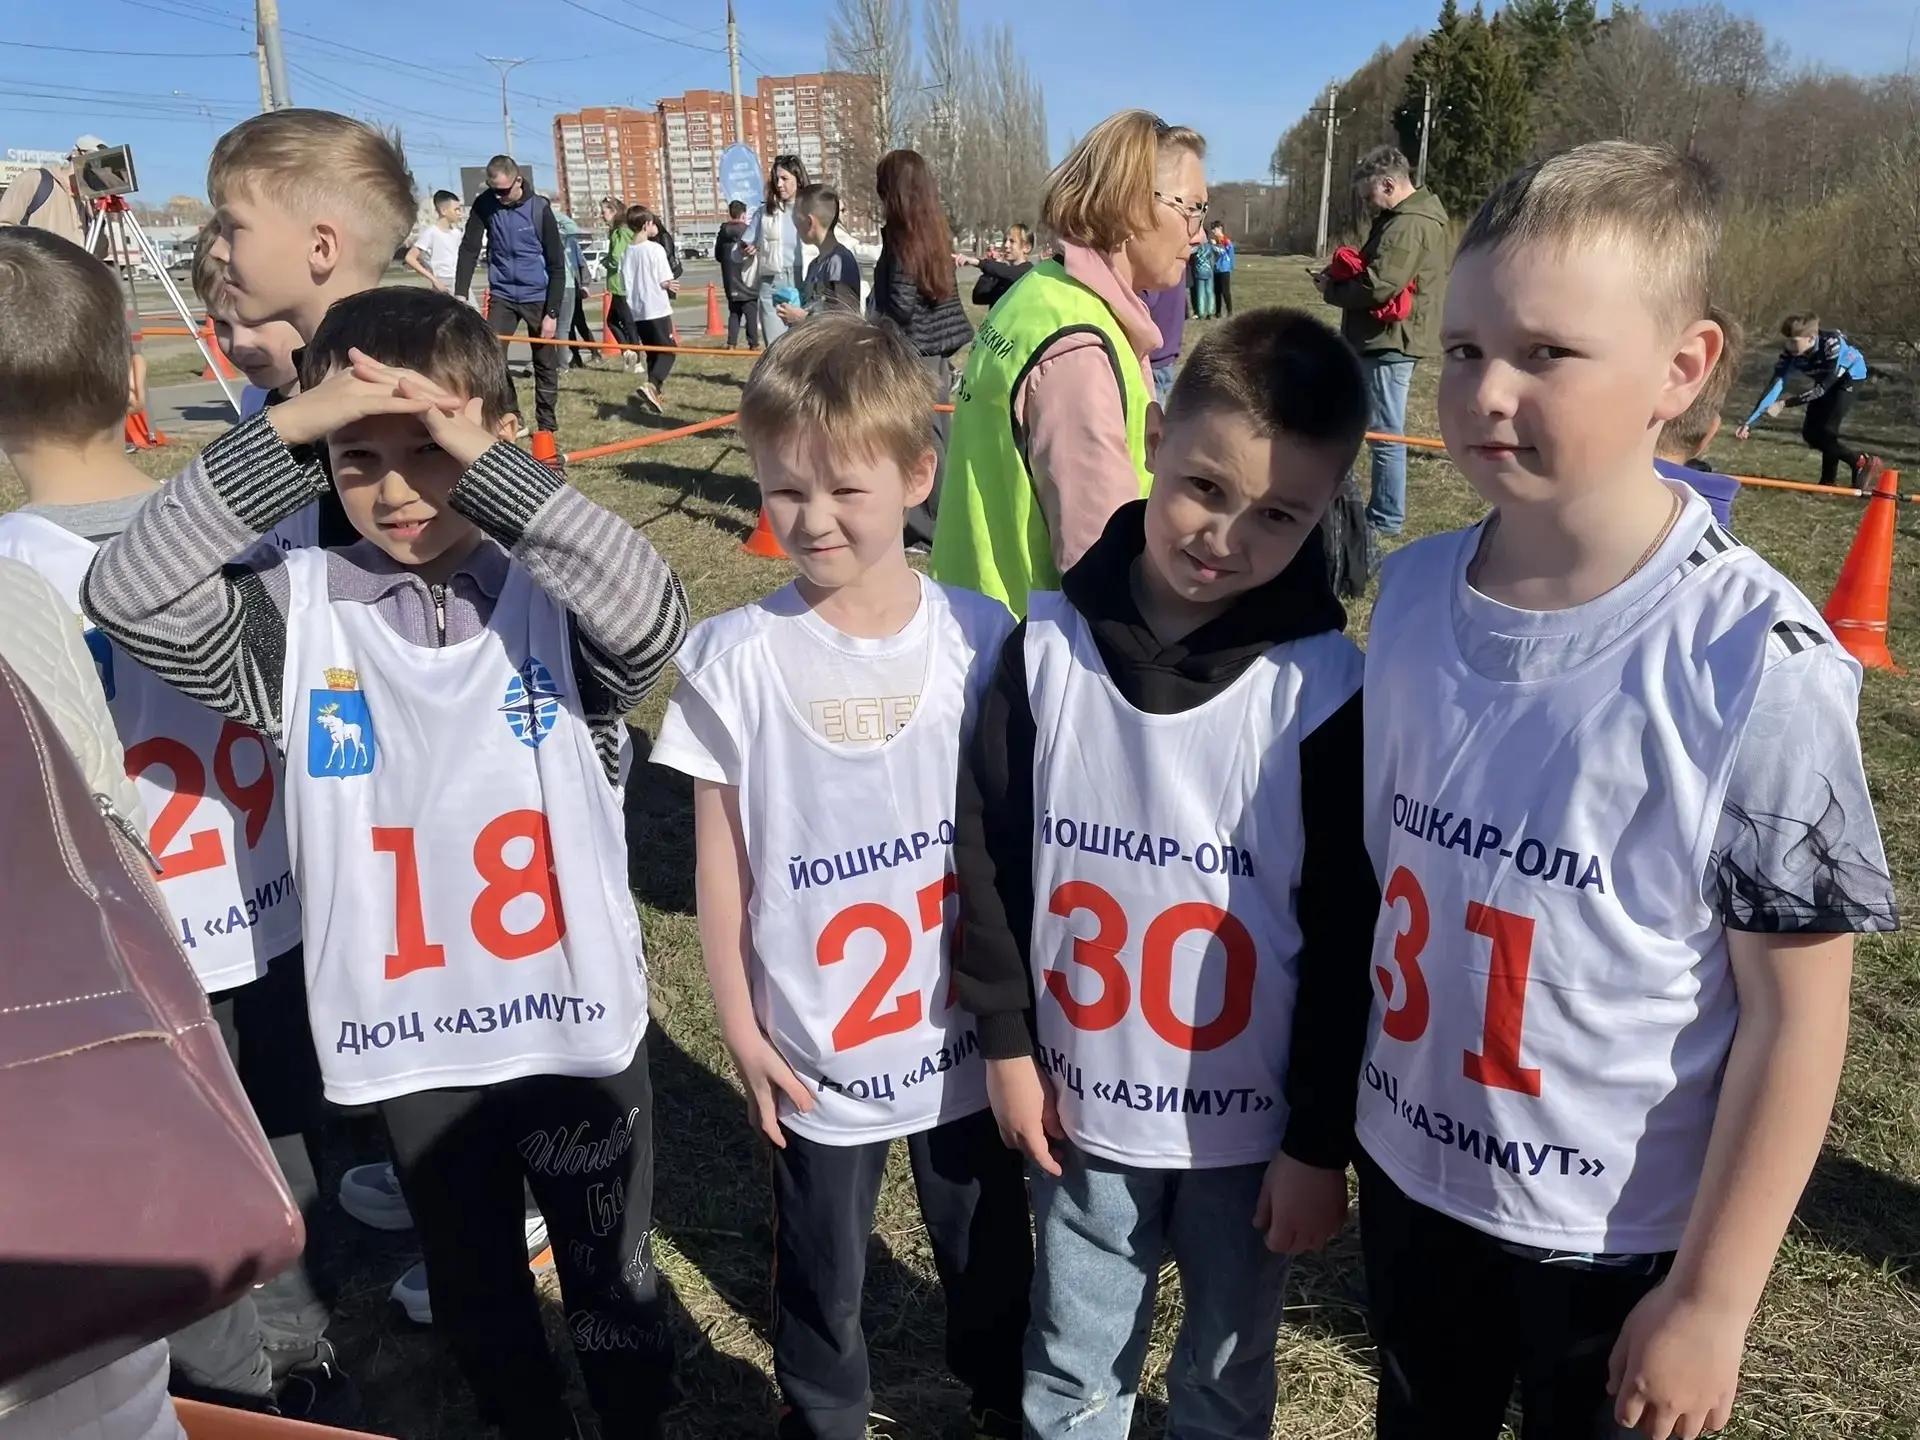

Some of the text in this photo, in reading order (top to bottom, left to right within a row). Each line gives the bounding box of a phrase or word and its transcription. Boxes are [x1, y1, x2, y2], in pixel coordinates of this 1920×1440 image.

[809, 695, 920, 742] EGE
[124, 719, 275, 882] 29
[1392, 793, 1606, 894] ОШКАР-ОЛА
[371, 809, 567, 980] 18
[788, 819, 956, 890] ЙОШКАР-О
[1043, 880, 1257, 1052] 30
[1375, 865, 1542, 1098] 31
[336, 992, 606, 1055] ДЮЦ «АЗИМУТ»
[1092, 1079, 1274, 1116] «АЗИМУТ»
[1401, 1098, 1606, 1178] «АЗИМУТ»
